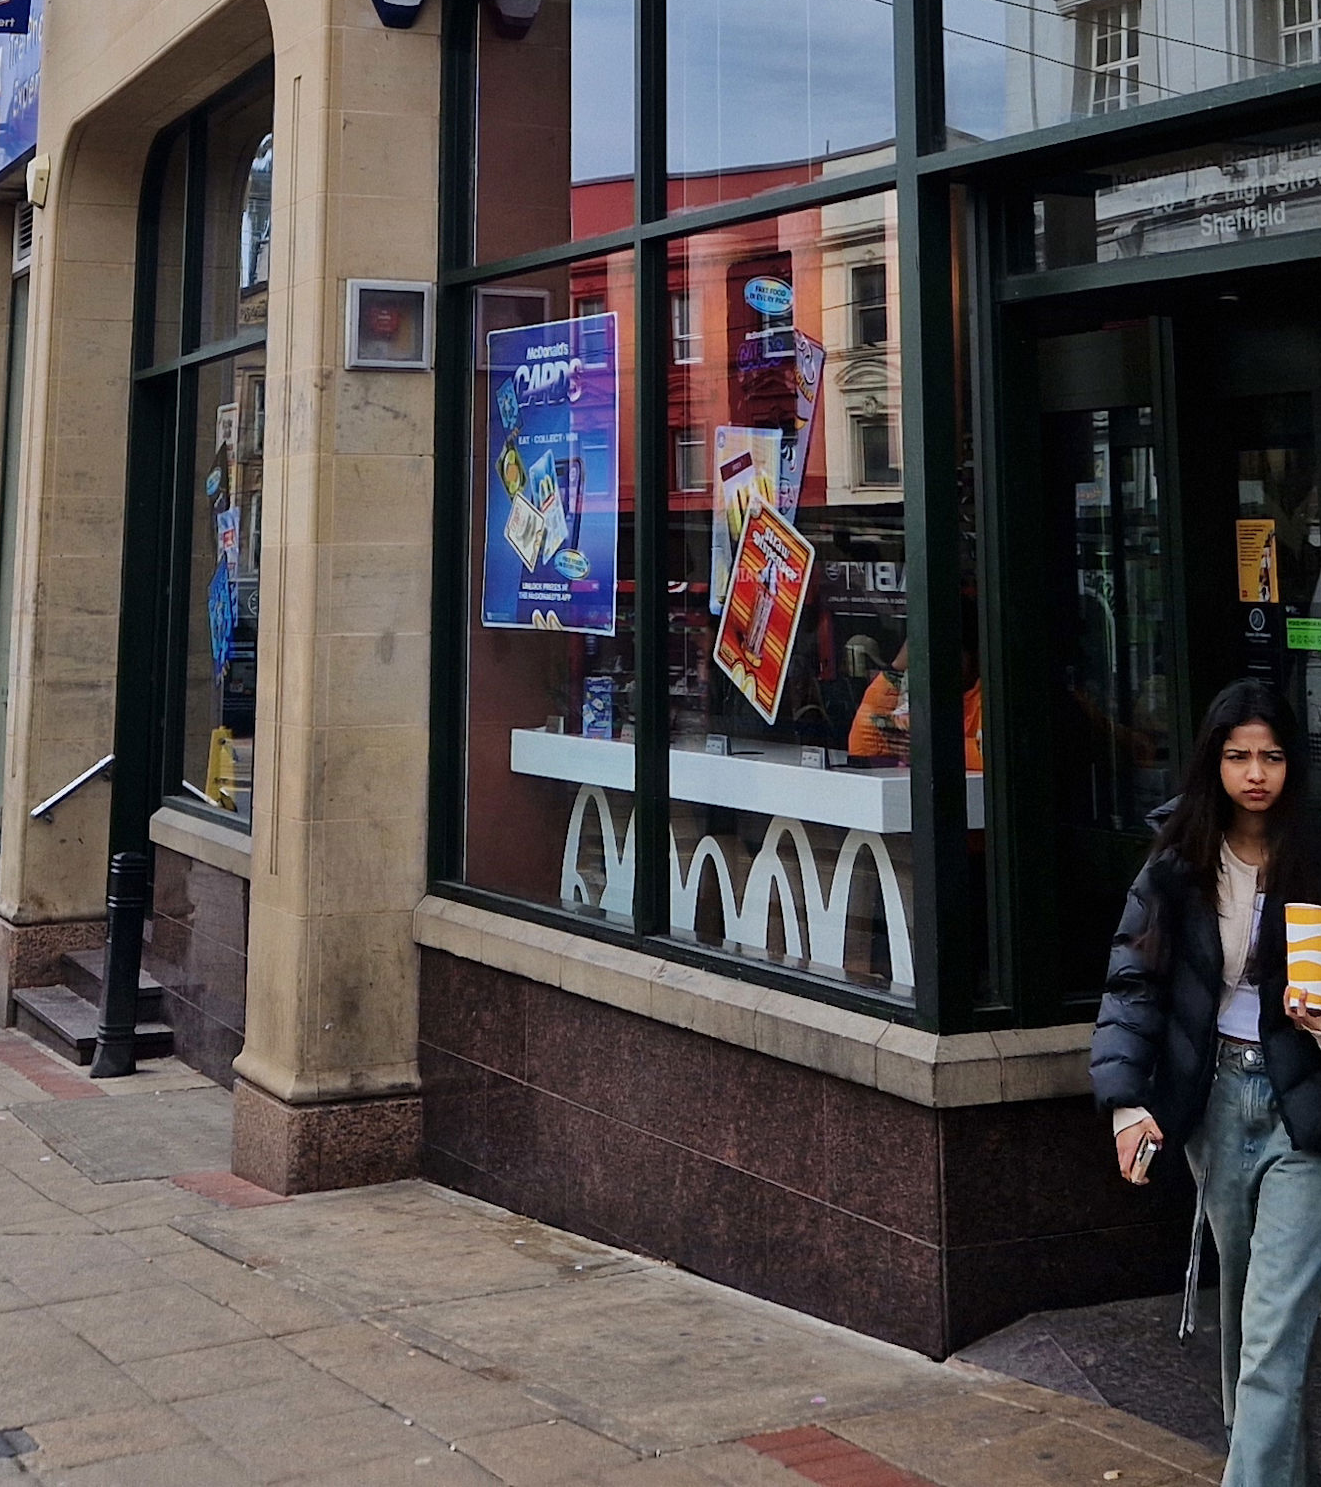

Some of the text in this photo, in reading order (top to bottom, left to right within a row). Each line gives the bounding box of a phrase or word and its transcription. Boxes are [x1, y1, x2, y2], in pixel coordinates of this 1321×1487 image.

[1199, 201, 1287, 237] Sheffield
[526, 341, 570, 361] McDonald's
[514, 357, 583, 409] CARDS
[533, 432, 563, 444] COLLECT
